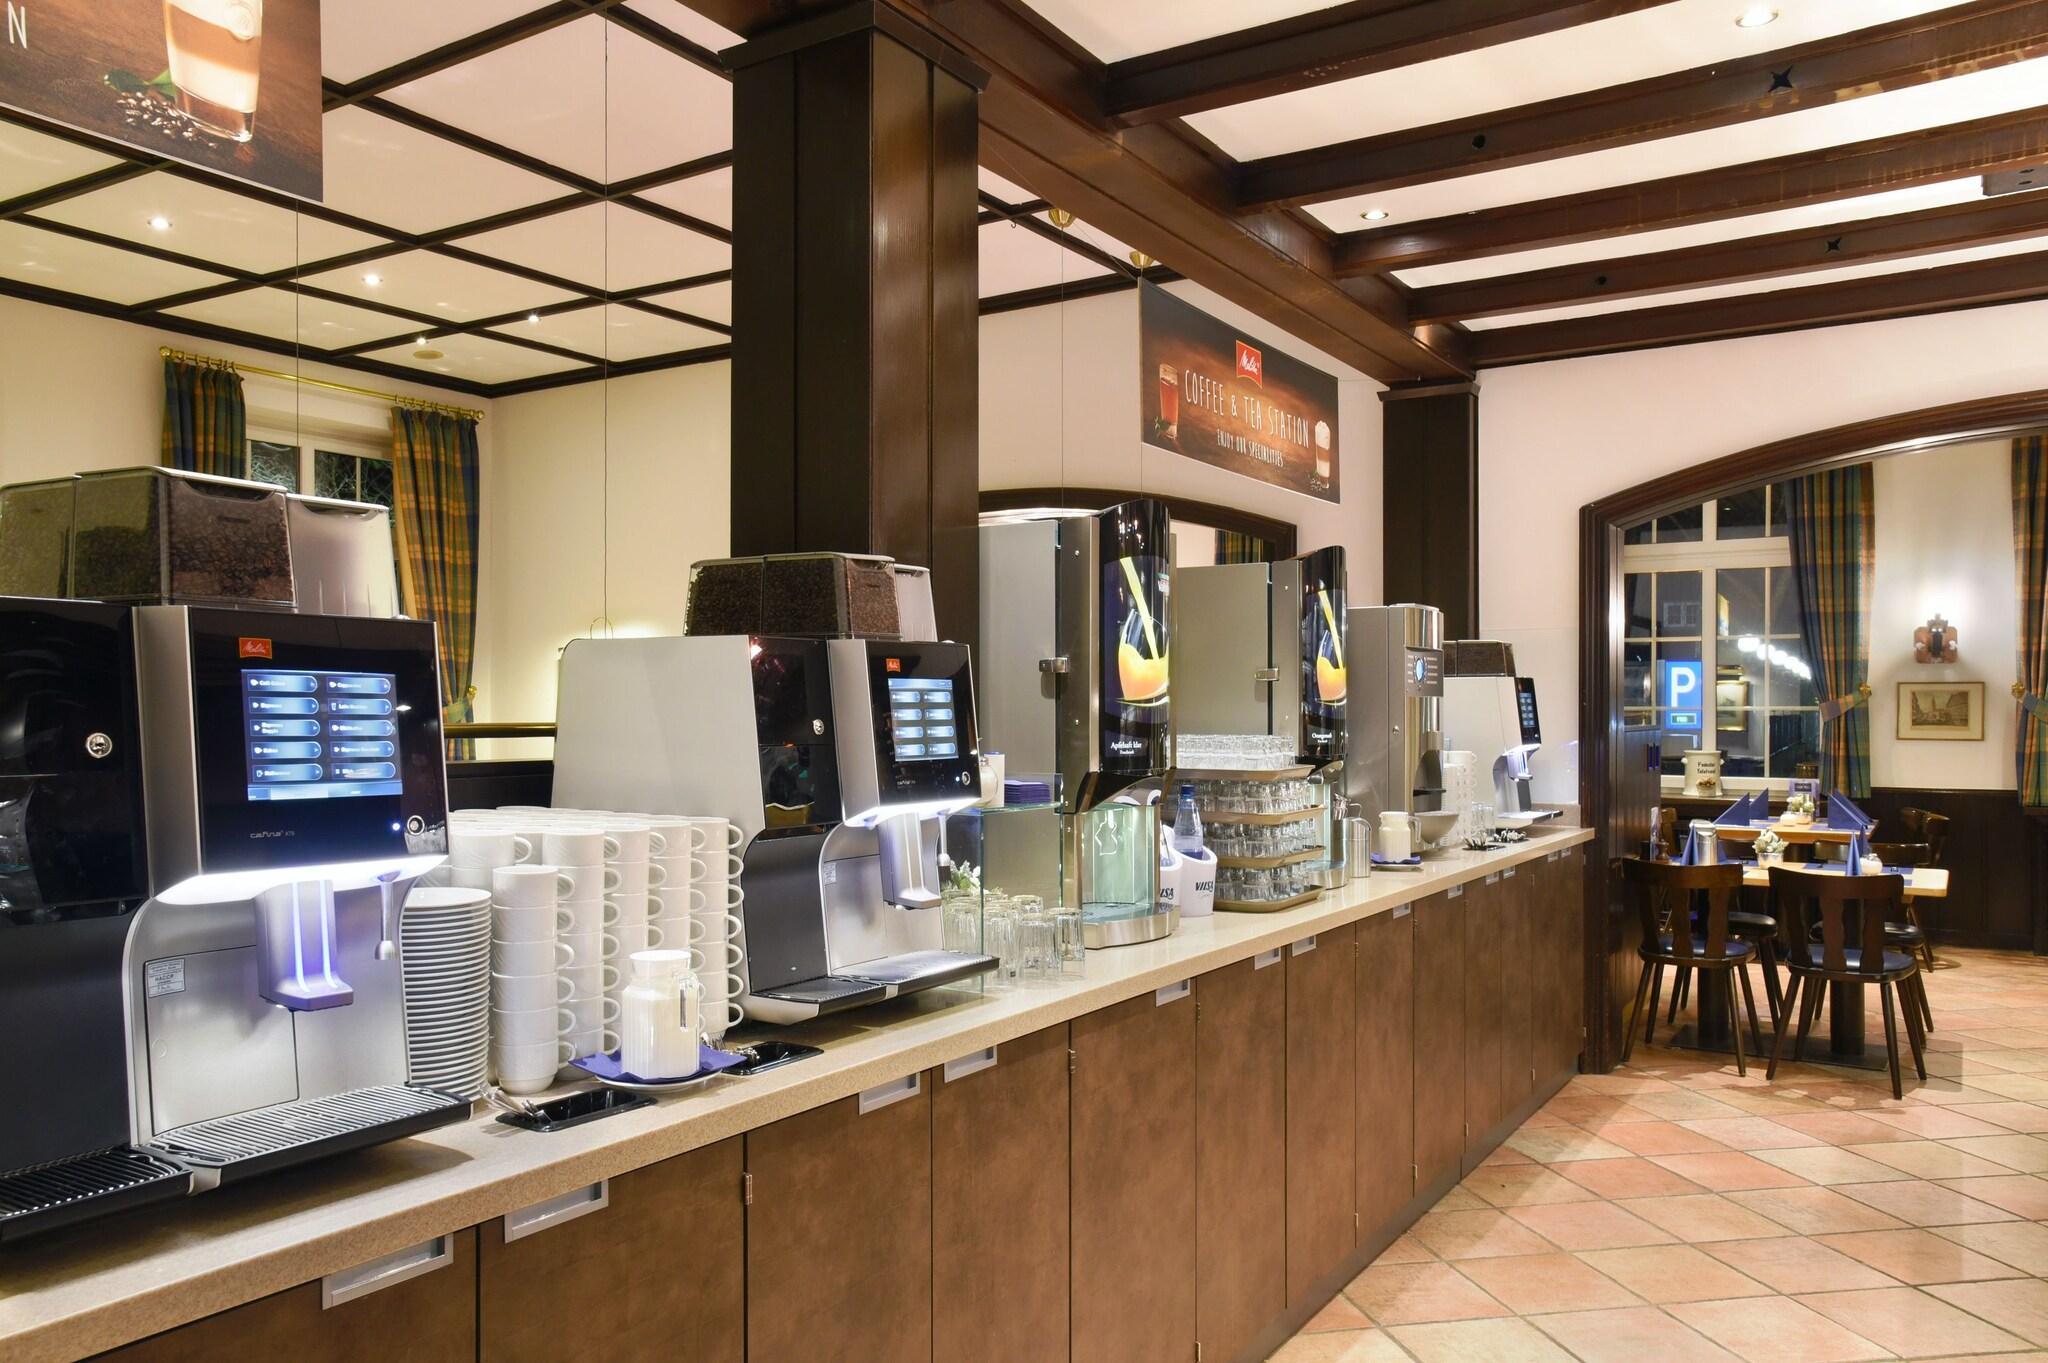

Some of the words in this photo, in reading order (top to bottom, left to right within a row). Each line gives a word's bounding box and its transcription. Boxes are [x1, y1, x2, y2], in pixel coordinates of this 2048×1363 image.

[1185, 369, 1225, 416] COFFEE
[1231, 394, 1238, 417] &
[1243, 396, 1262, 431] TEA
[1268, 405, 1309, 448] STATION
[1671, 667, 1696, 708] P
[1160, 887, 1174, 900] LSA
